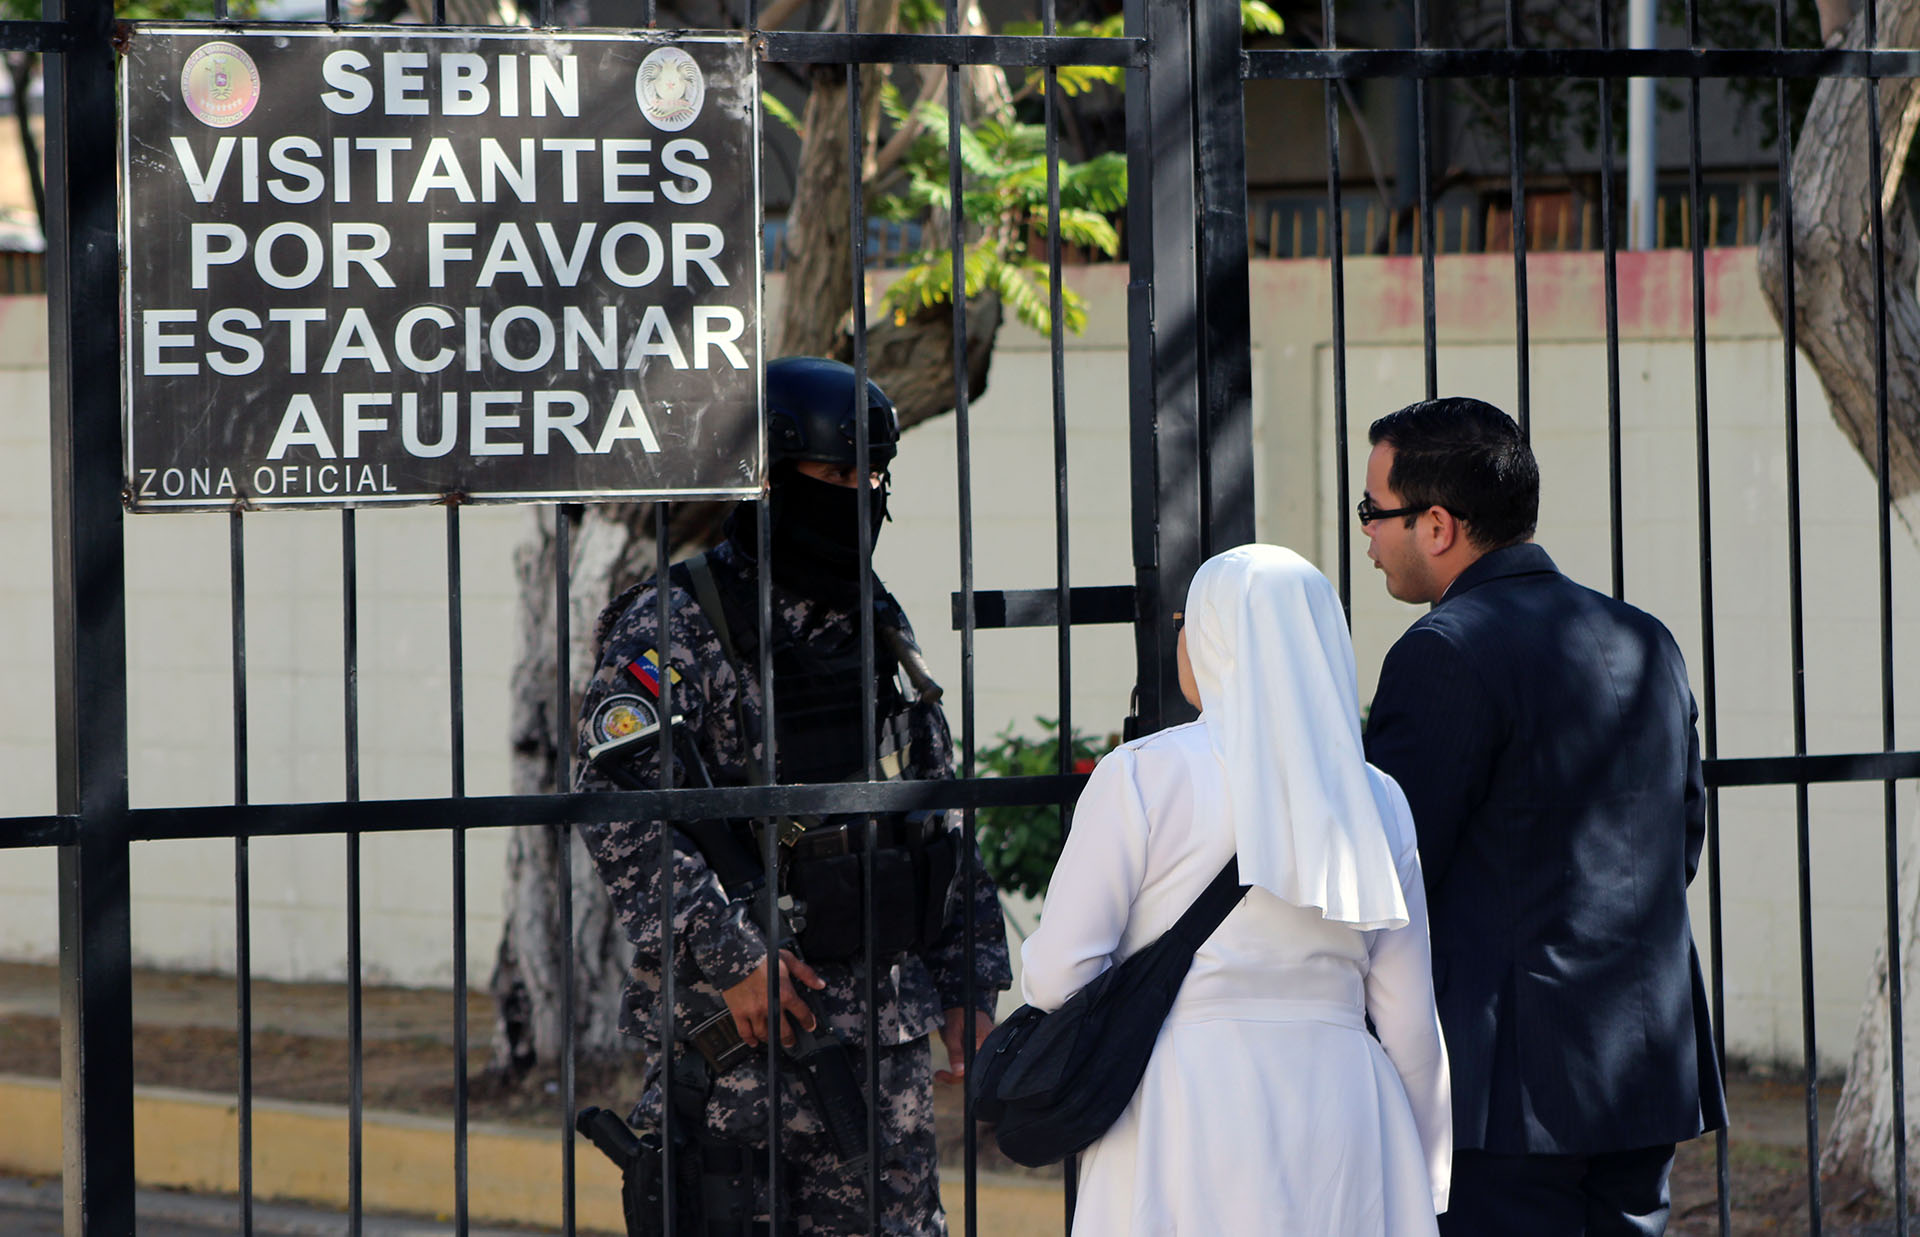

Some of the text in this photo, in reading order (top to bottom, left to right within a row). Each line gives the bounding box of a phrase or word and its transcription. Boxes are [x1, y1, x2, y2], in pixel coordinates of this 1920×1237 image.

[320, 49, 580, 117] SEBIN
[170, 136, 711, 204] VISITANTES
[191, 222, 730, 290] POR FAVOR
[143, 306, 749, 376] ESTACIONAR
[266, 390, 661, 460] AFUERA
[139, 464, 397, 496] ZONA OFICIAL
